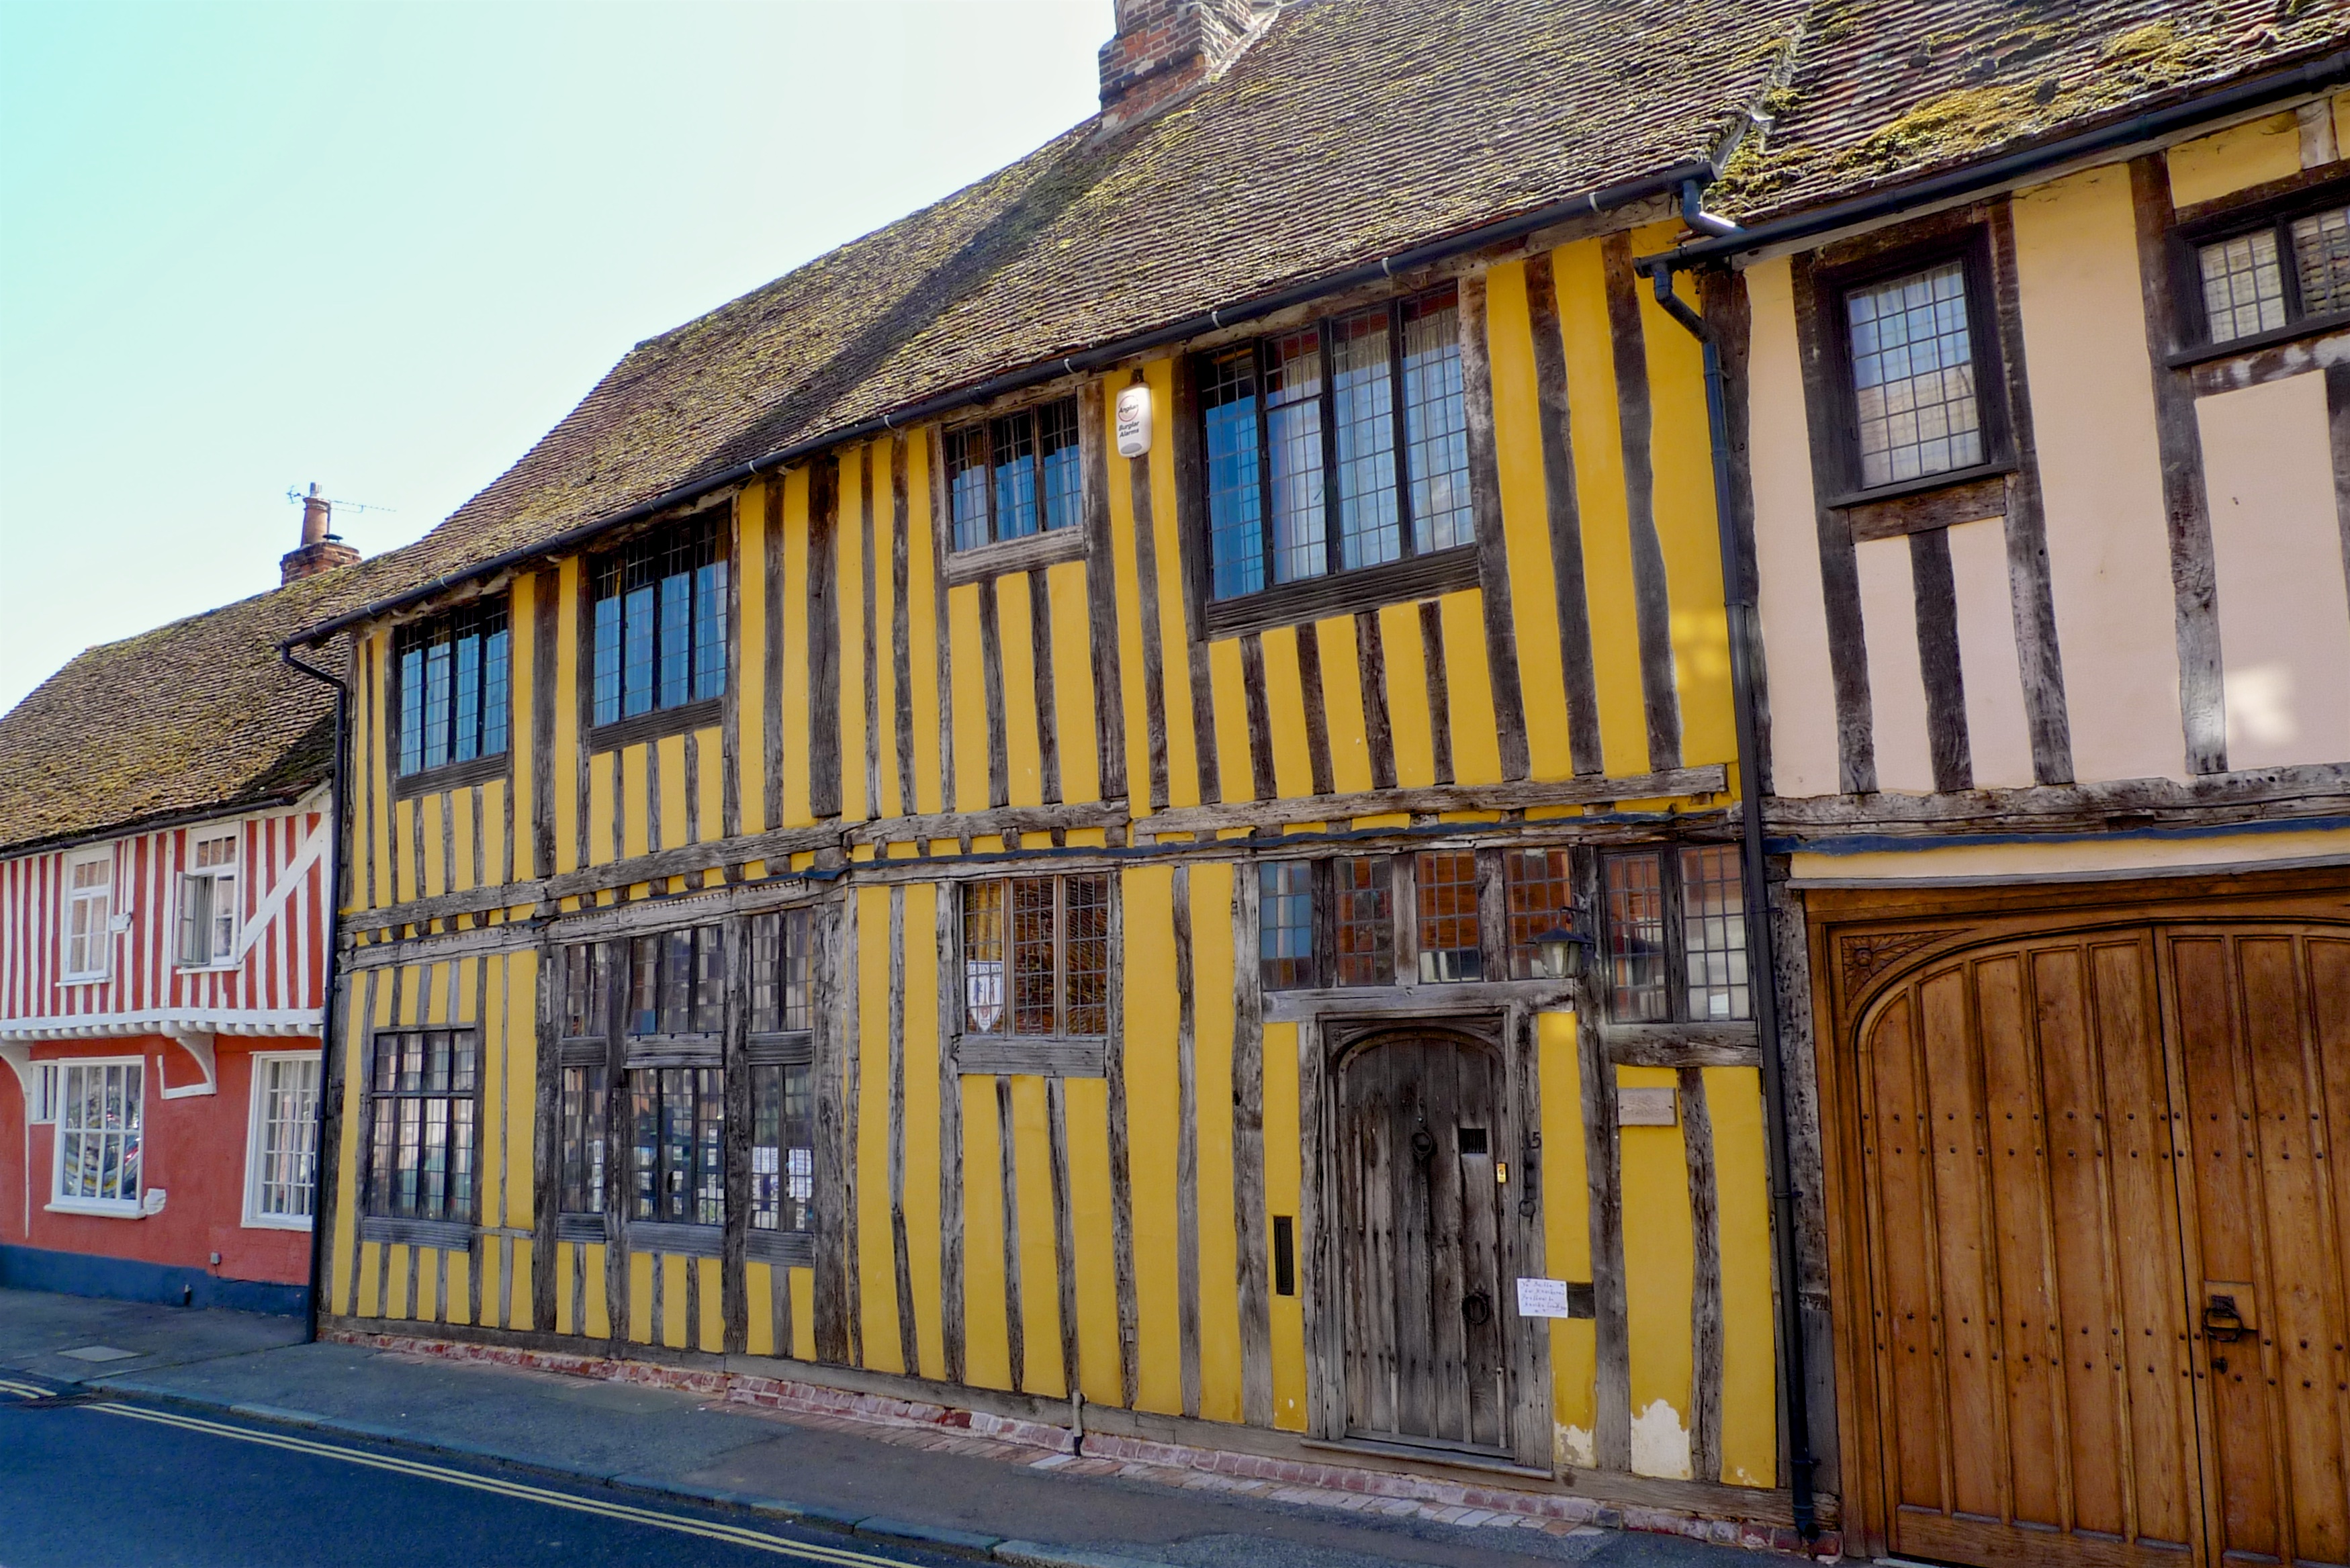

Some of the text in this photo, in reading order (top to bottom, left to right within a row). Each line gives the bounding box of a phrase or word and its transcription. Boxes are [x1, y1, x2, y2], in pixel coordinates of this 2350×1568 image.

[1119, 421, 1139, 431] Burglar
[1120, 428, 1139, 438] Alarms
[1531, 1131, 1541, 1148] 5
